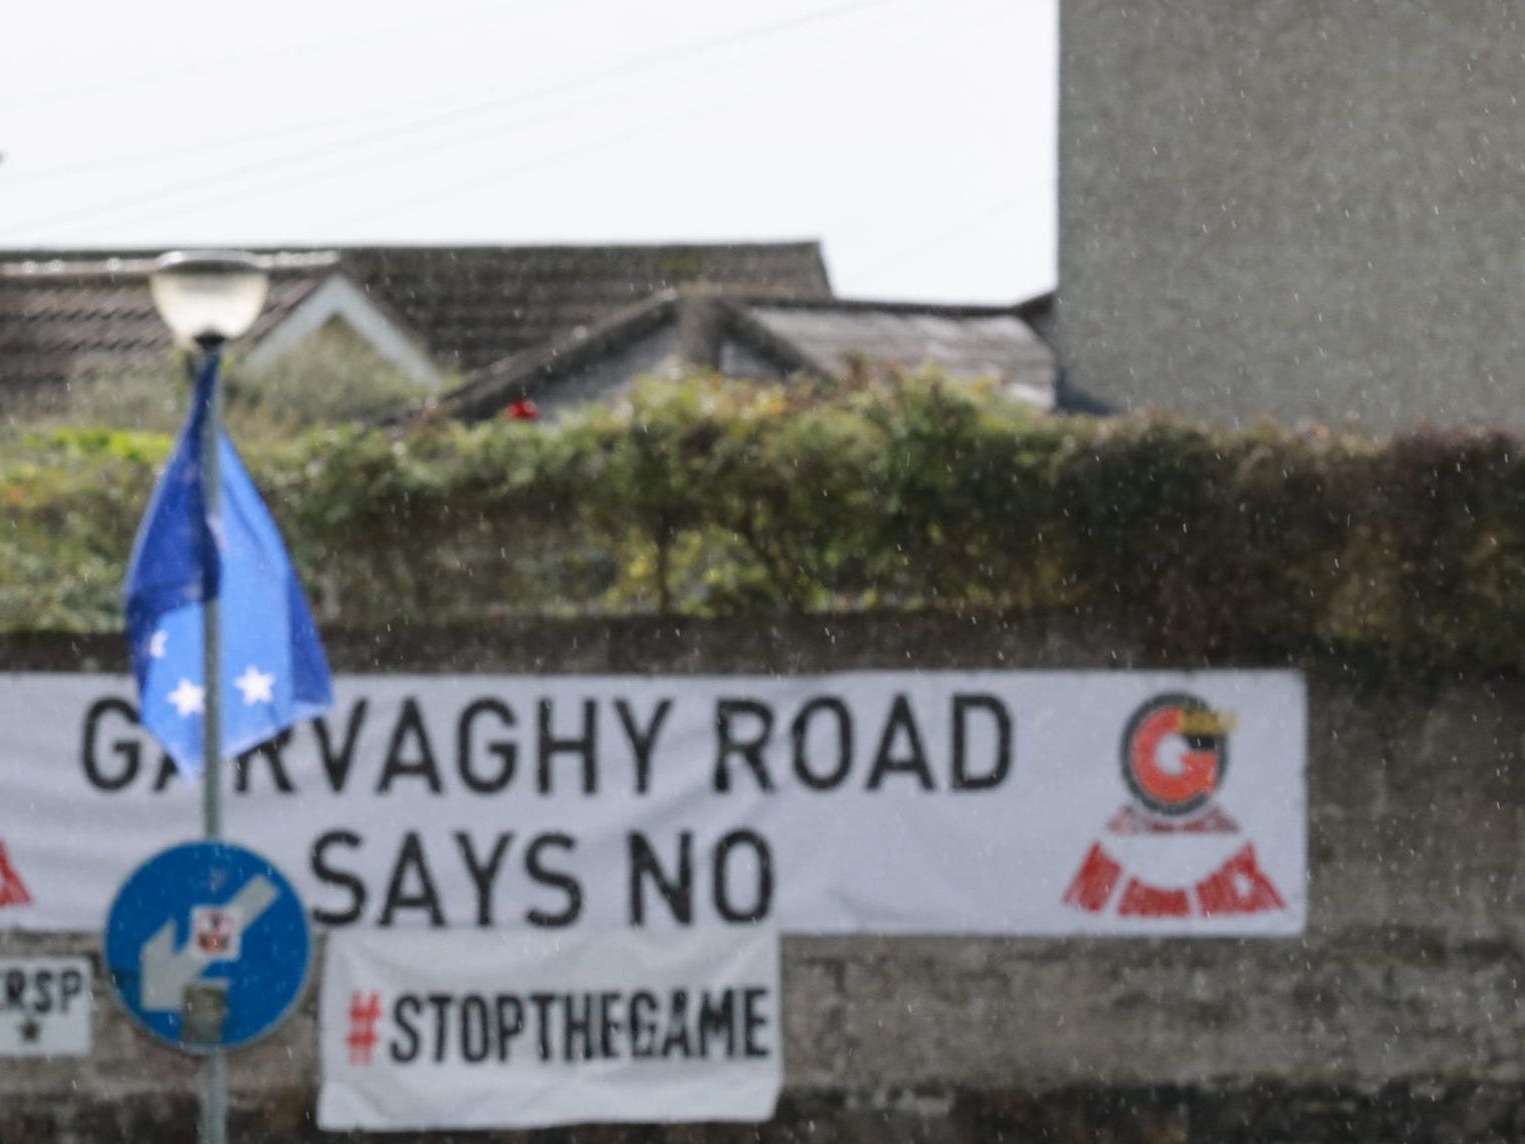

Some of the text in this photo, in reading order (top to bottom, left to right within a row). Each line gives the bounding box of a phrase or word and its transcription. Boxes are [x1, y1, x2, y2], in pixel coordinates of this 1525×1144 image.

[82, 691, 1015, 795] GRVAGHY ROAD
[310, 828, 775, 930] SAYS NO
[344, 986, 771, 1067] #STOPTHEGAME
